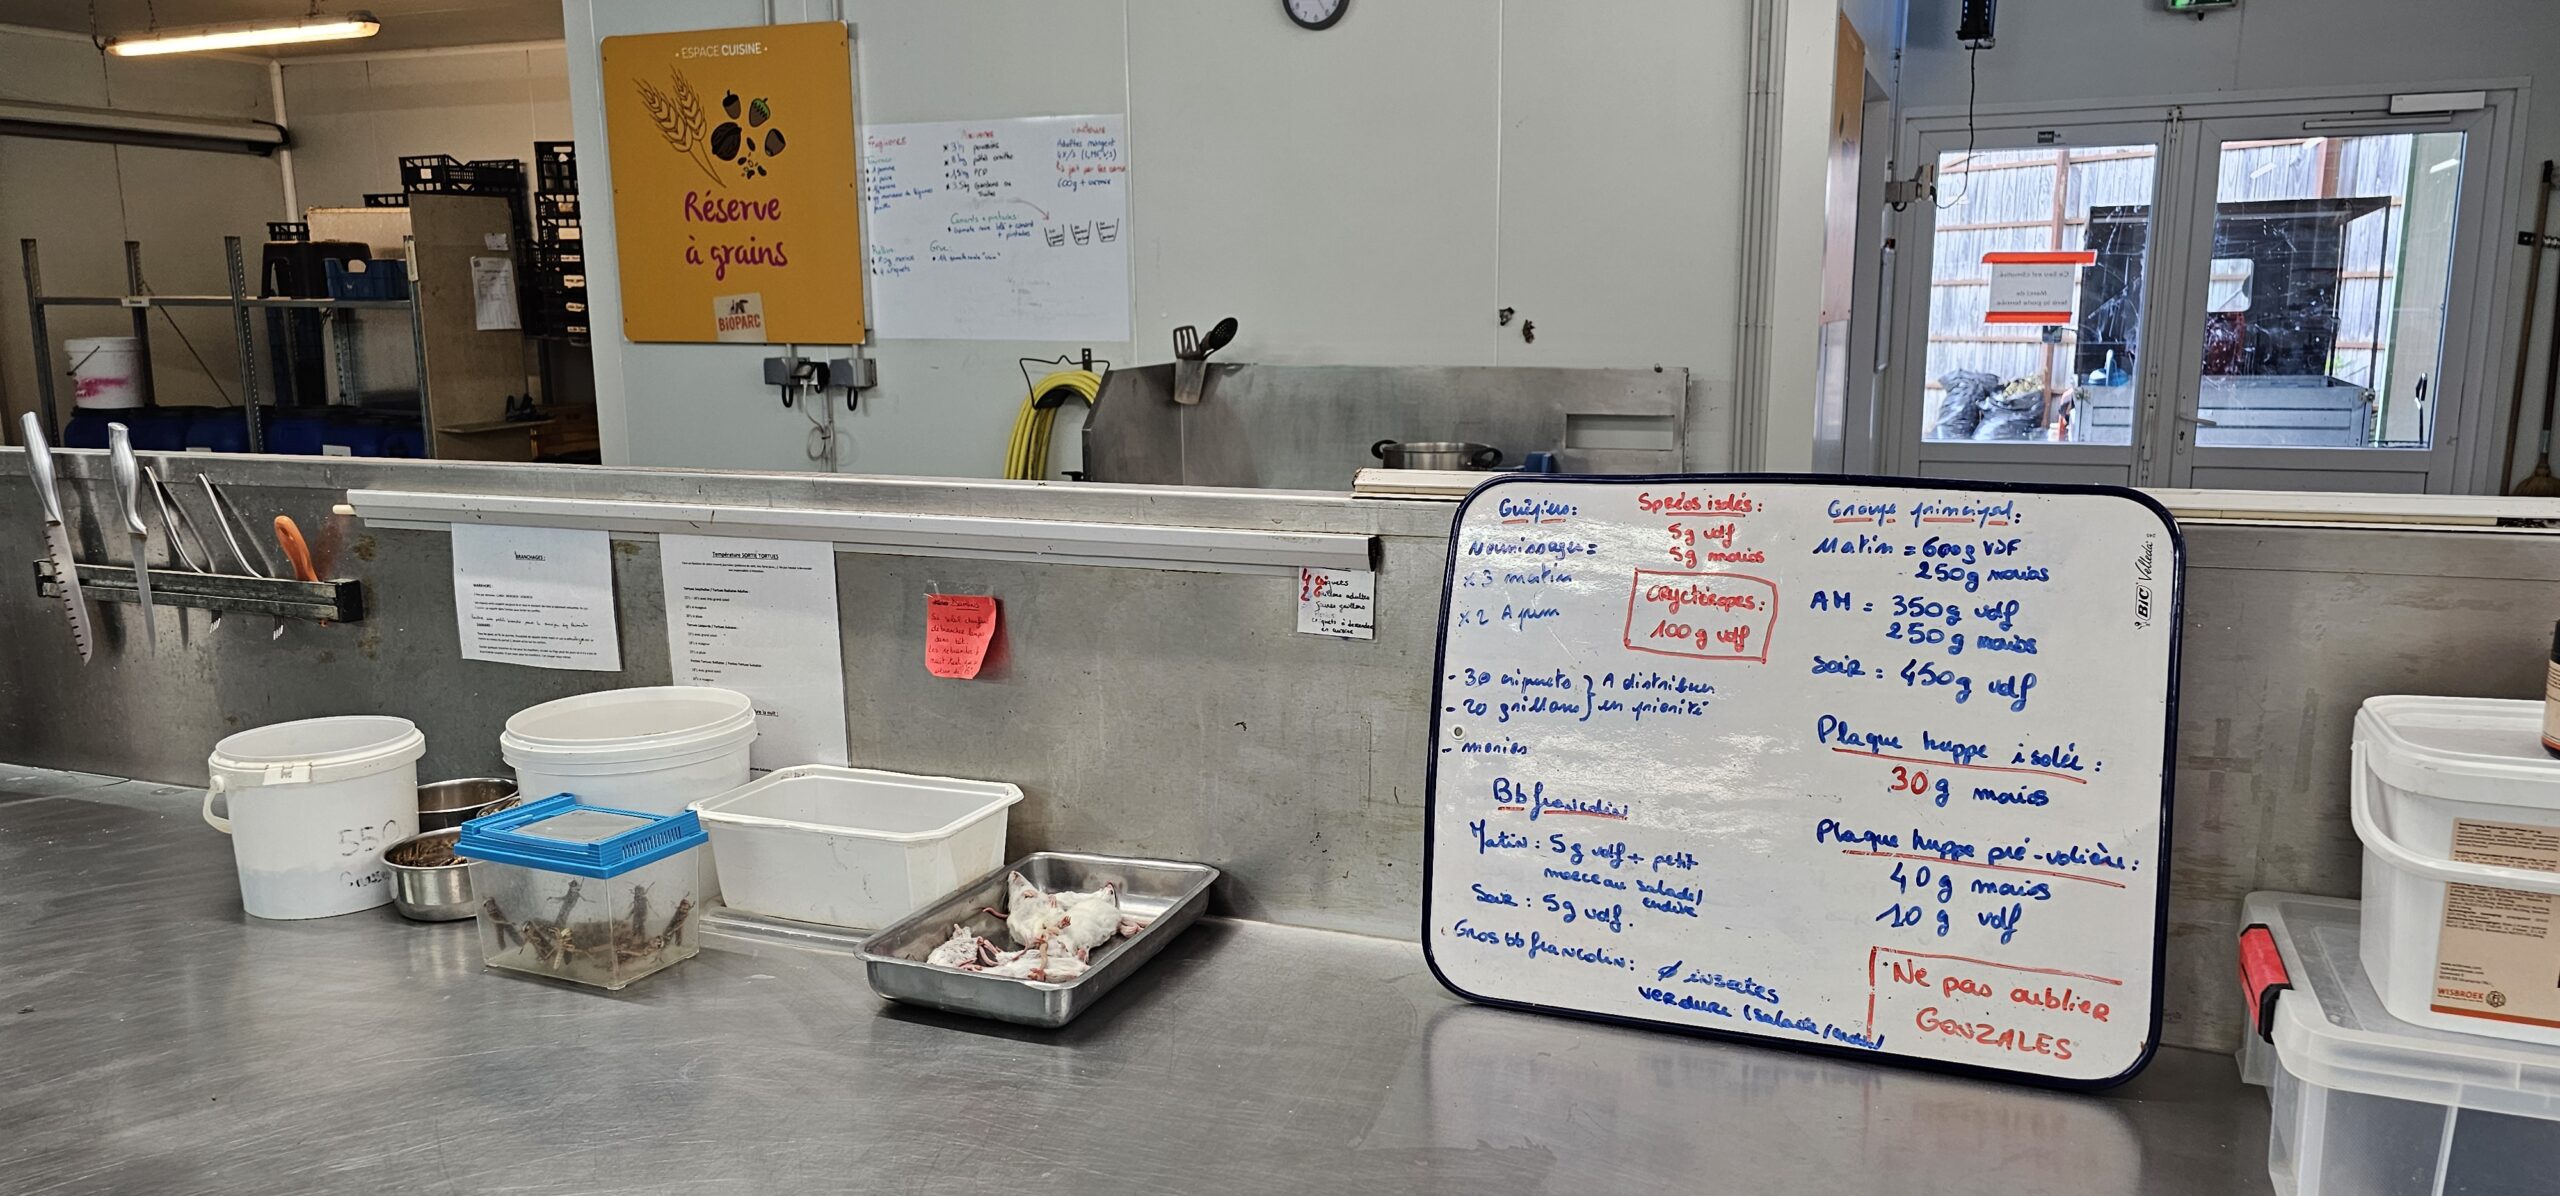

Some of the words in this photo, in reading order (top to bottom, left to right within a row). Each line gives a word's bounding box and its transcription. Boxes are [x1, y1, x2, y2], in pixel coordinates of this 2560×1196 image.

[681, 45, 720, 58] ESPACE
[721, 42, 762, 57] CUISINE
[684, 189, 782, 223] Réserve
[685, 235, 704, 265] à
[710, 236, 788, 281] grains
[1827, 499, 1897, 528] Groupe
[1812, 534, 1894, 554] Matin
[1503, 563, 1573, 585] matin
[2134, 541, 2153, 581] Velleda
[1301, 567, 1312, 586] 4
[1300, 586, 1311, 601] 2
[1345, 592, 1370, 601] adultes
[2137, 587, 2150, 618] BIC
[1462, 698, 1488, 716] 20
[1498, 696, 1580, 723] grillons
[1597, 698, 1624, 712] en
[1632, 698, 1710, 722] priorité
[1817, 714, 1903, 755] Plaque
[1923, 730, 1989, 765] huppe
[1493, 777, 1528, 805] Bb
[1469, 818, 1528, 855] Matin
[1652, 851, 1699, 873] petit
[1816, 818, 1900, 853] Plaque
[1912, 829, 1976, 862] huppe
[1543, 867, 1627, 891] morceau
[1471, 883, 1519, 908] Soir
[1453, 918, 1500, 945] Gros
[1504, 931, 1526, 948] bb
[1683, 969, 1780, 1005] insectes
[1892, 958, 1932, 988] Ne
[1942, 975, 1994, 998] pas
[2009, 988, 2111, 1023] oublier
[2437, 987, 2484, 1001] WISBROEK
[1637, 986, 1733, 1018] verdure
